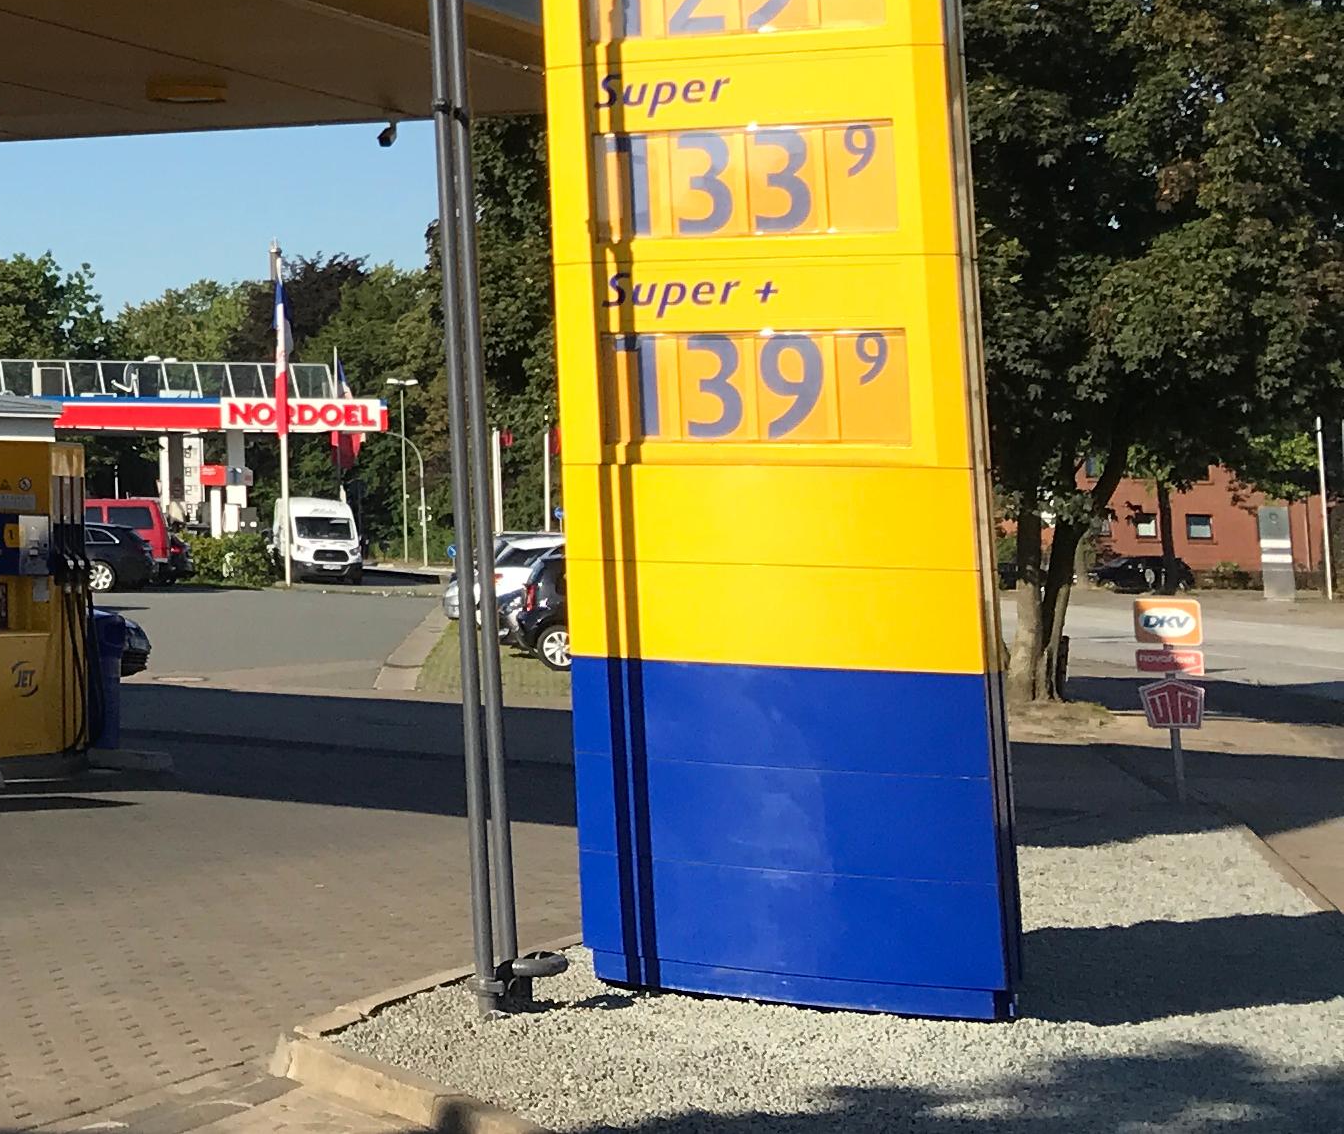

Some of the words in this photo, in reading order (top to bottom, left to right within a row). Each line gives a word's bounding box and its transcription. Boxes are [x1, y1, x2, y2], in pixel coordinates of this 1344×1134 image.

[594, 73, 731, 118] Super
[602, 272, 741, 319] Super
[1143, 615, 1190, 628] DKV
[14, 669, 36, 688] JET
[1145, 682, 1200, 724] UTA
